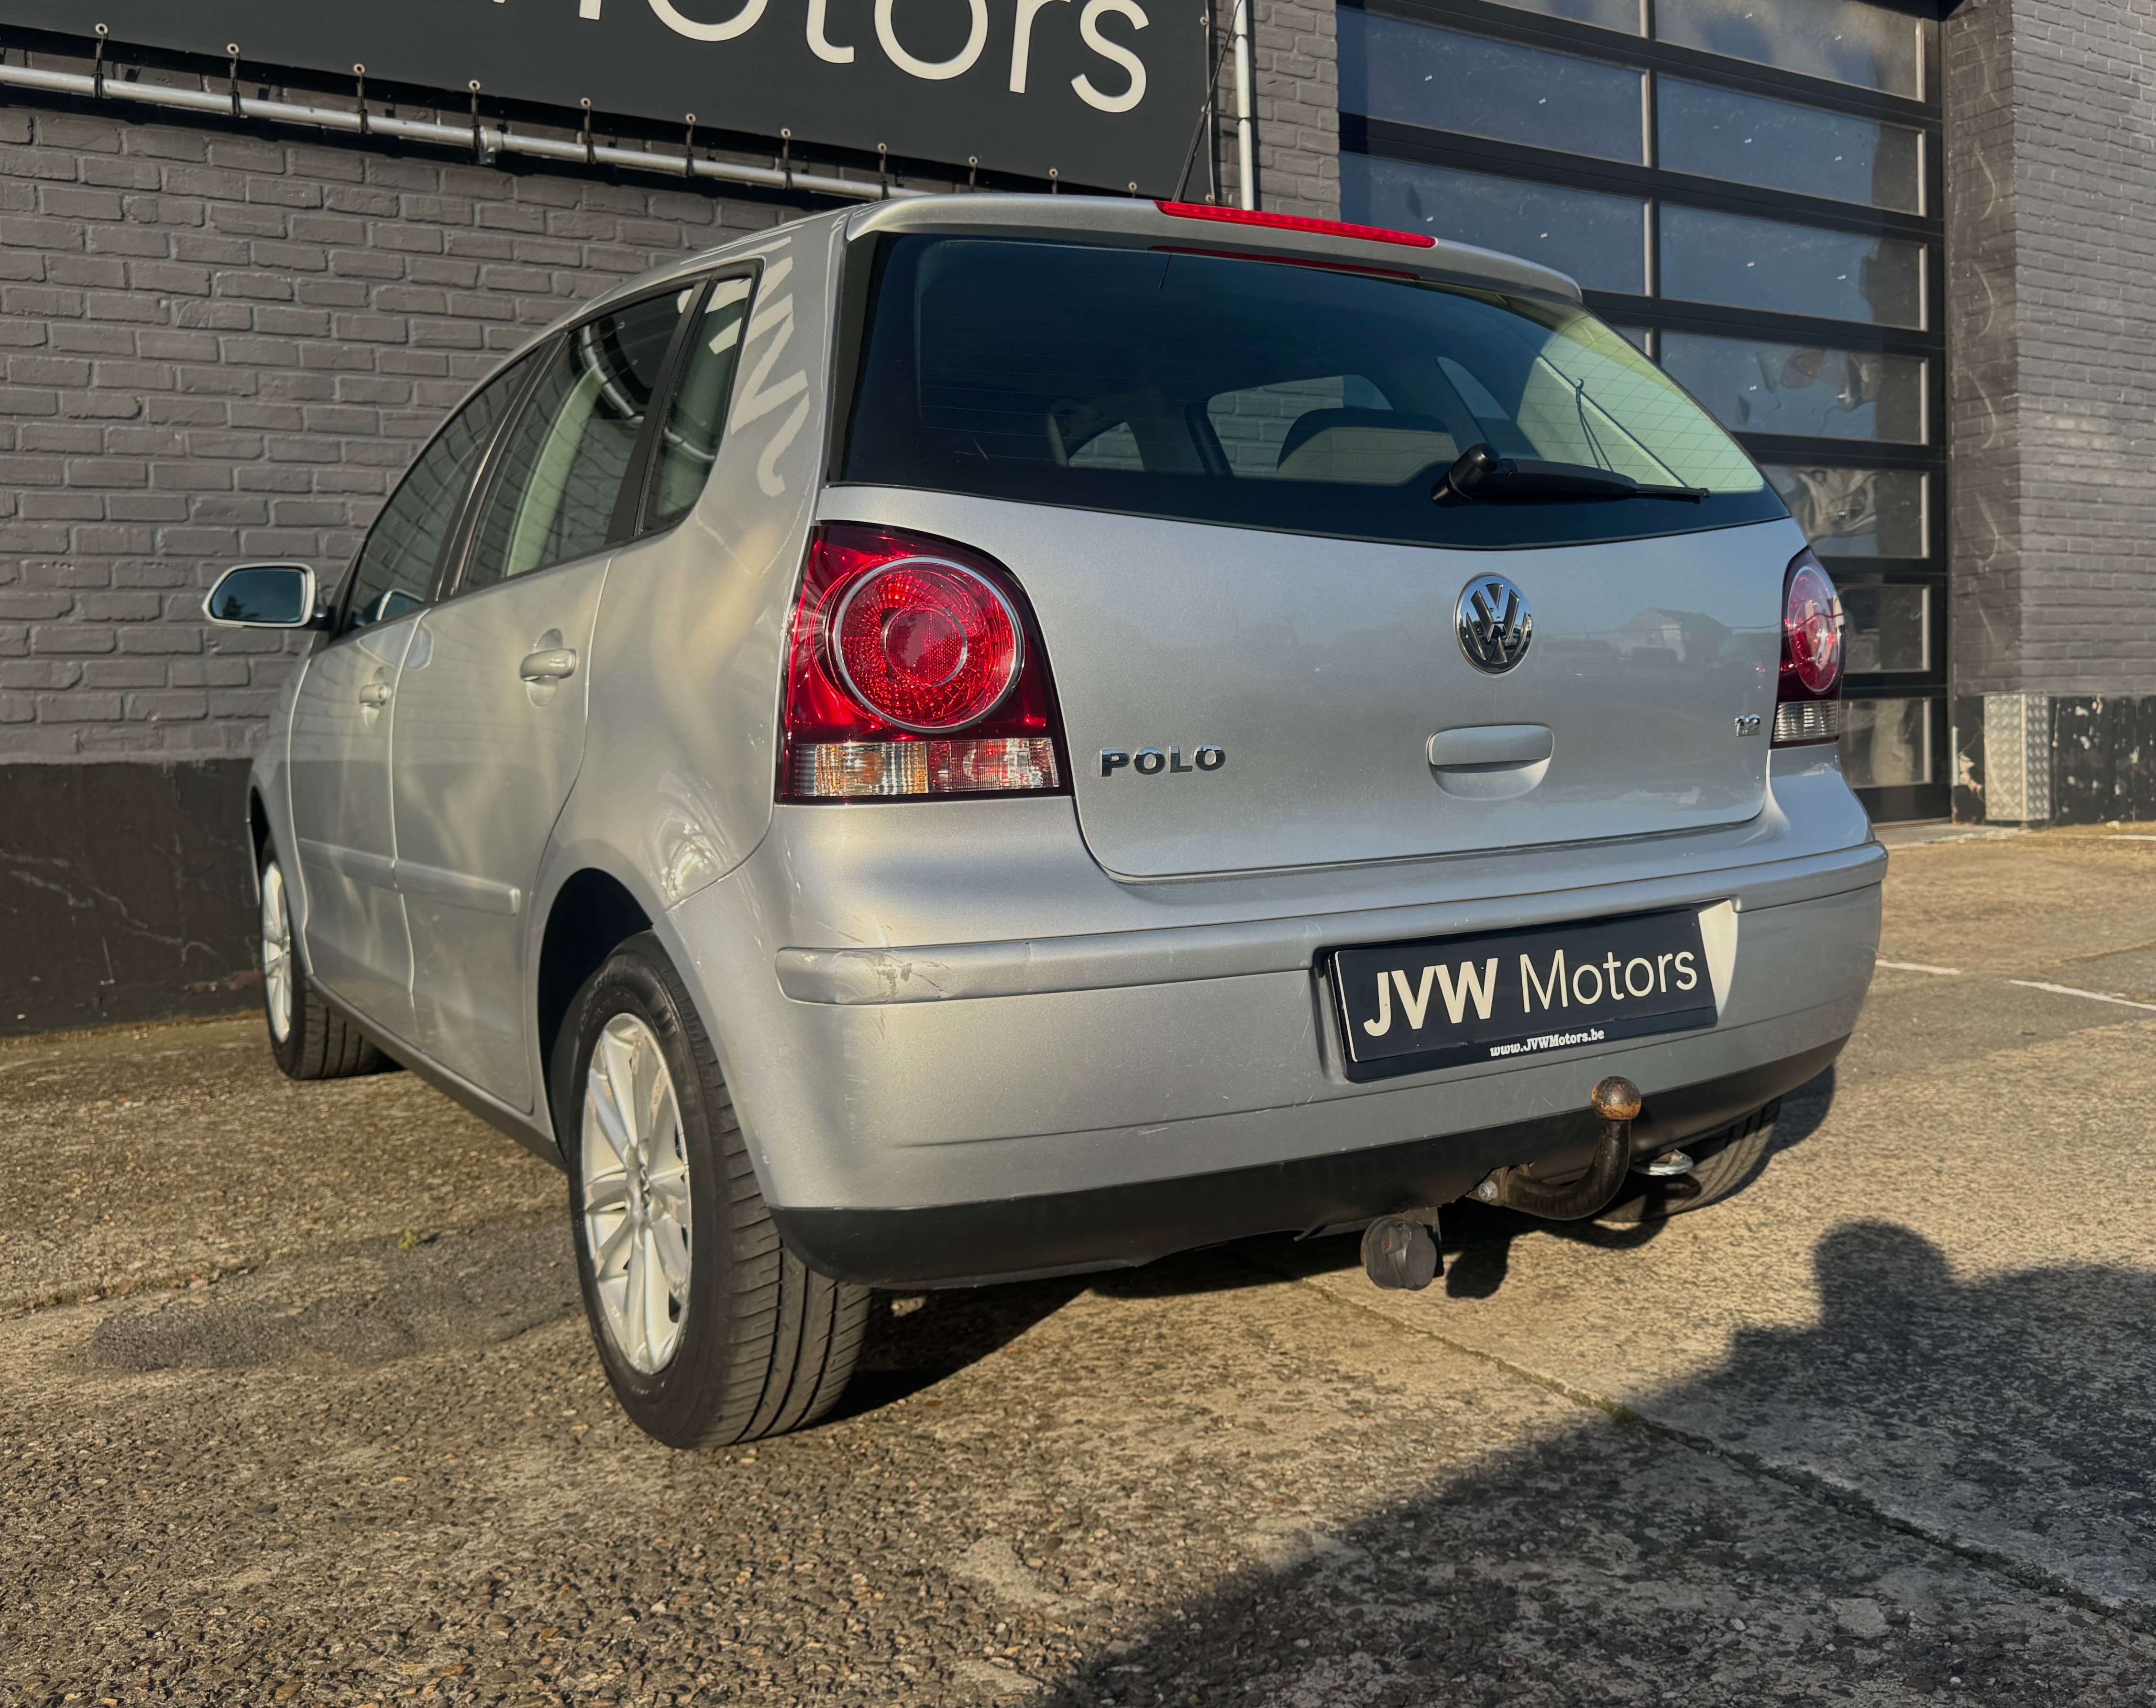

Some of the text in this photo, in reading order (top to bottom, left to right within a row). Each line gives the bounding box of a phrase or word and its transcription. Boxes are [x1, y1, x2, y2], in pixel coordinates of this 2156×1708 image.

[1457, 575, 1532, 673] VW
[1100, 744, 1226, 777] POLO
[1363, 949, 1698, 1037] JVW Motors
[1489, 1028, 1605, 1057] www.JVWMotors.be
